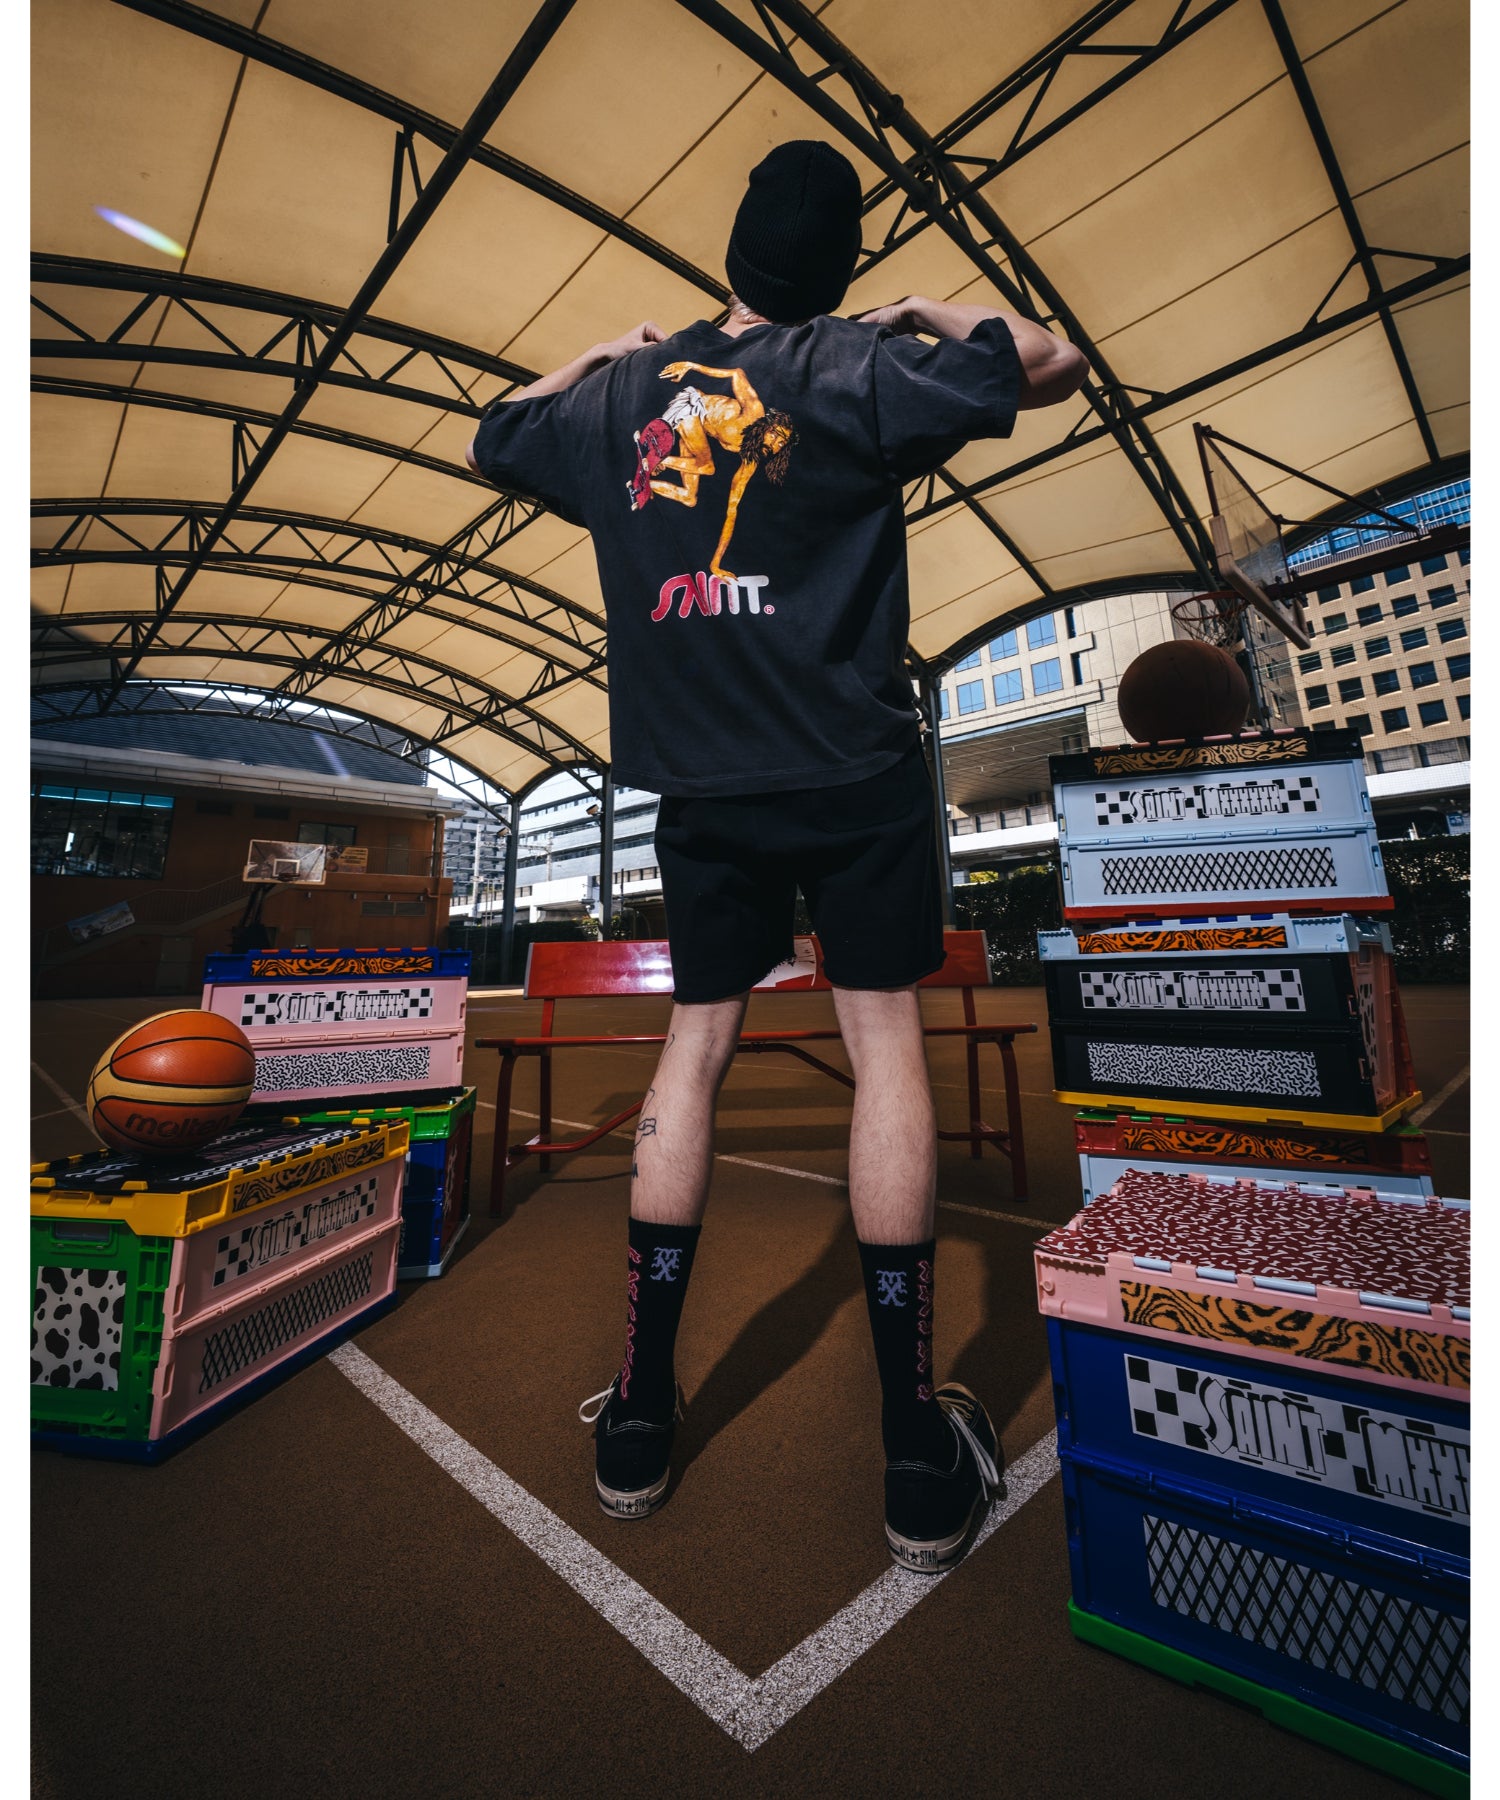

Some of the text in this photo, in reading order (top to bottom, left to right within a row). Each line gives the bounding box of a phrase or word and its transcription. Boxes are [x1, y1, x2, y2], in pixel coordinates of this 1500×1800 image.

[1128, 790, 1187, 823] SAINT
[1111, 974, 1167, 1007] SAINT
[273, 993, 328, 1023] SAINT
[125, 1112, 231, 1138] molten
[1199, 1376, 1327, 1476] SAINT
